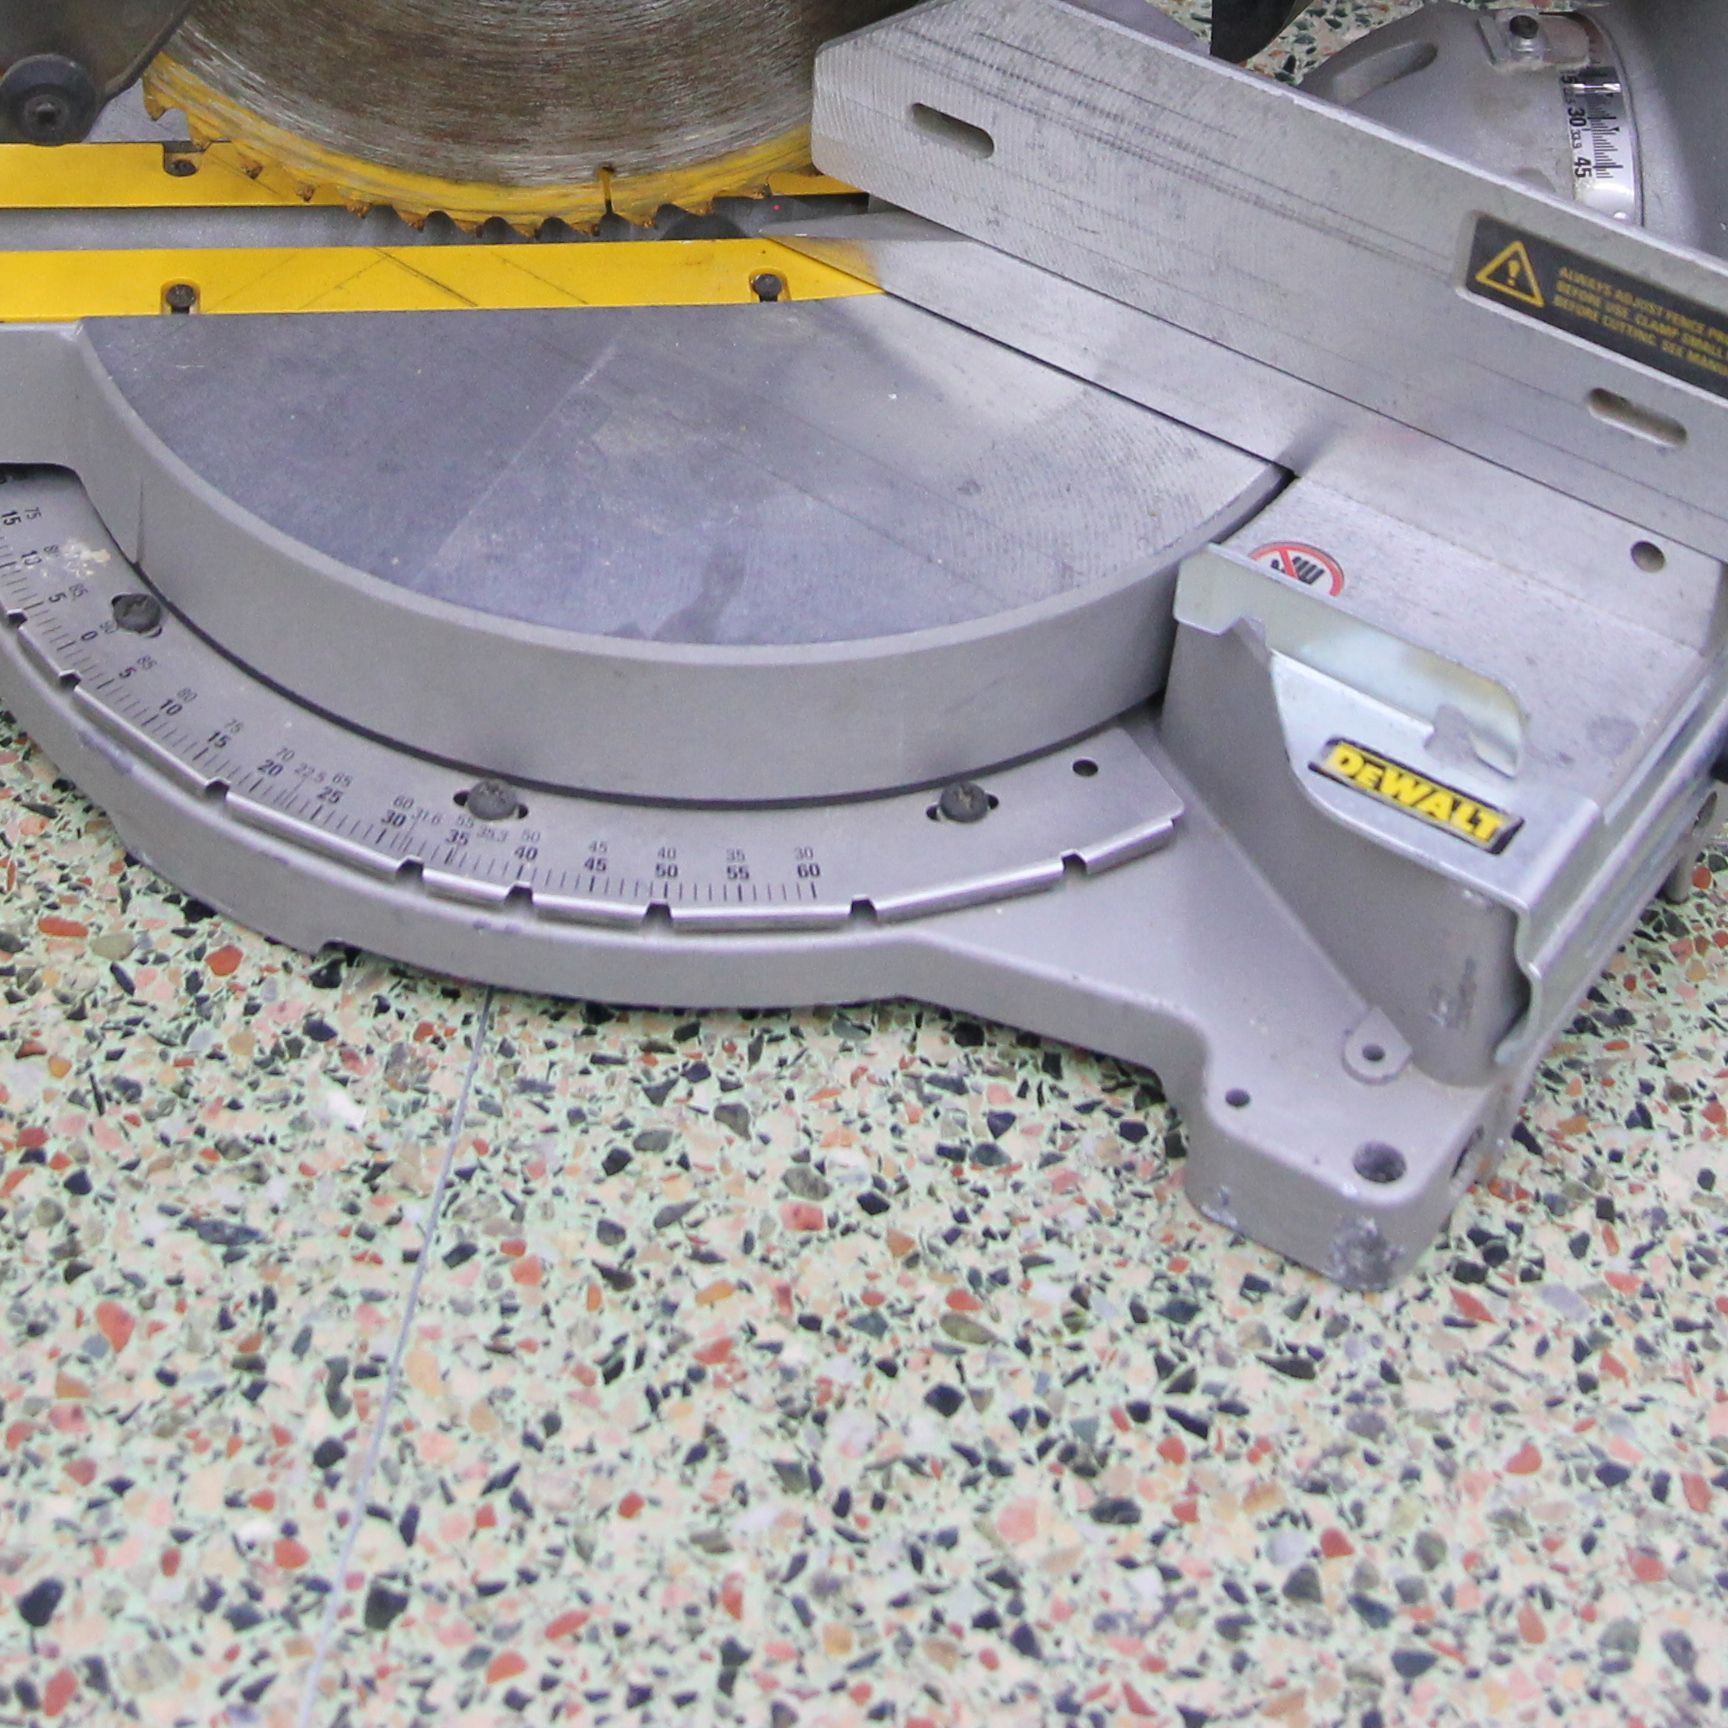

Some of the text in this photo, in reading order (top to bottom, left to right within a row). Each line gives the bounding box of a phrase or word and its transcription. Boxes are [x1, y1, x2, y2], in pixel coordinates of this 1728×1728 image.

[1567, 108, 1587, 127] 30
[1573, 157, 1592, 178] 45
[1, 510, 22, 526] 15
[20, 550, 42, 566] 10
[48, 591, 68, 604] 5
[80, 630, 99, 642] 0
[118, 666, 137, 679] 5
[160, 698, 184, 716] 10
[207, 730, 231, 749] 15
[276, 747, 296, 762] 70
[257, 759, 284, 777] 20
[332, 772, 354, 787] 65
[317, 786, 344, 804] 25
[1330, 742, 1503, 843] DEWALT
[393, 795, 415, 809] 60
[380, 809, 407, 827] 30
[446, 828, 469, 846] 35
[522, 829, 541, 842] 50
[514, 846, 539, 862] 40
[588, 841, 608, 853] 45
[657, 847, 676, 860] 40
[795, 847, 814, 861] 30
[726, 849, 746, 862] 35
[584, 857, 607, 872] 45
[655, 863, 679, 878] 50
[797, 863, 821, 879] 60
[726, 865, 750, 880] 55
